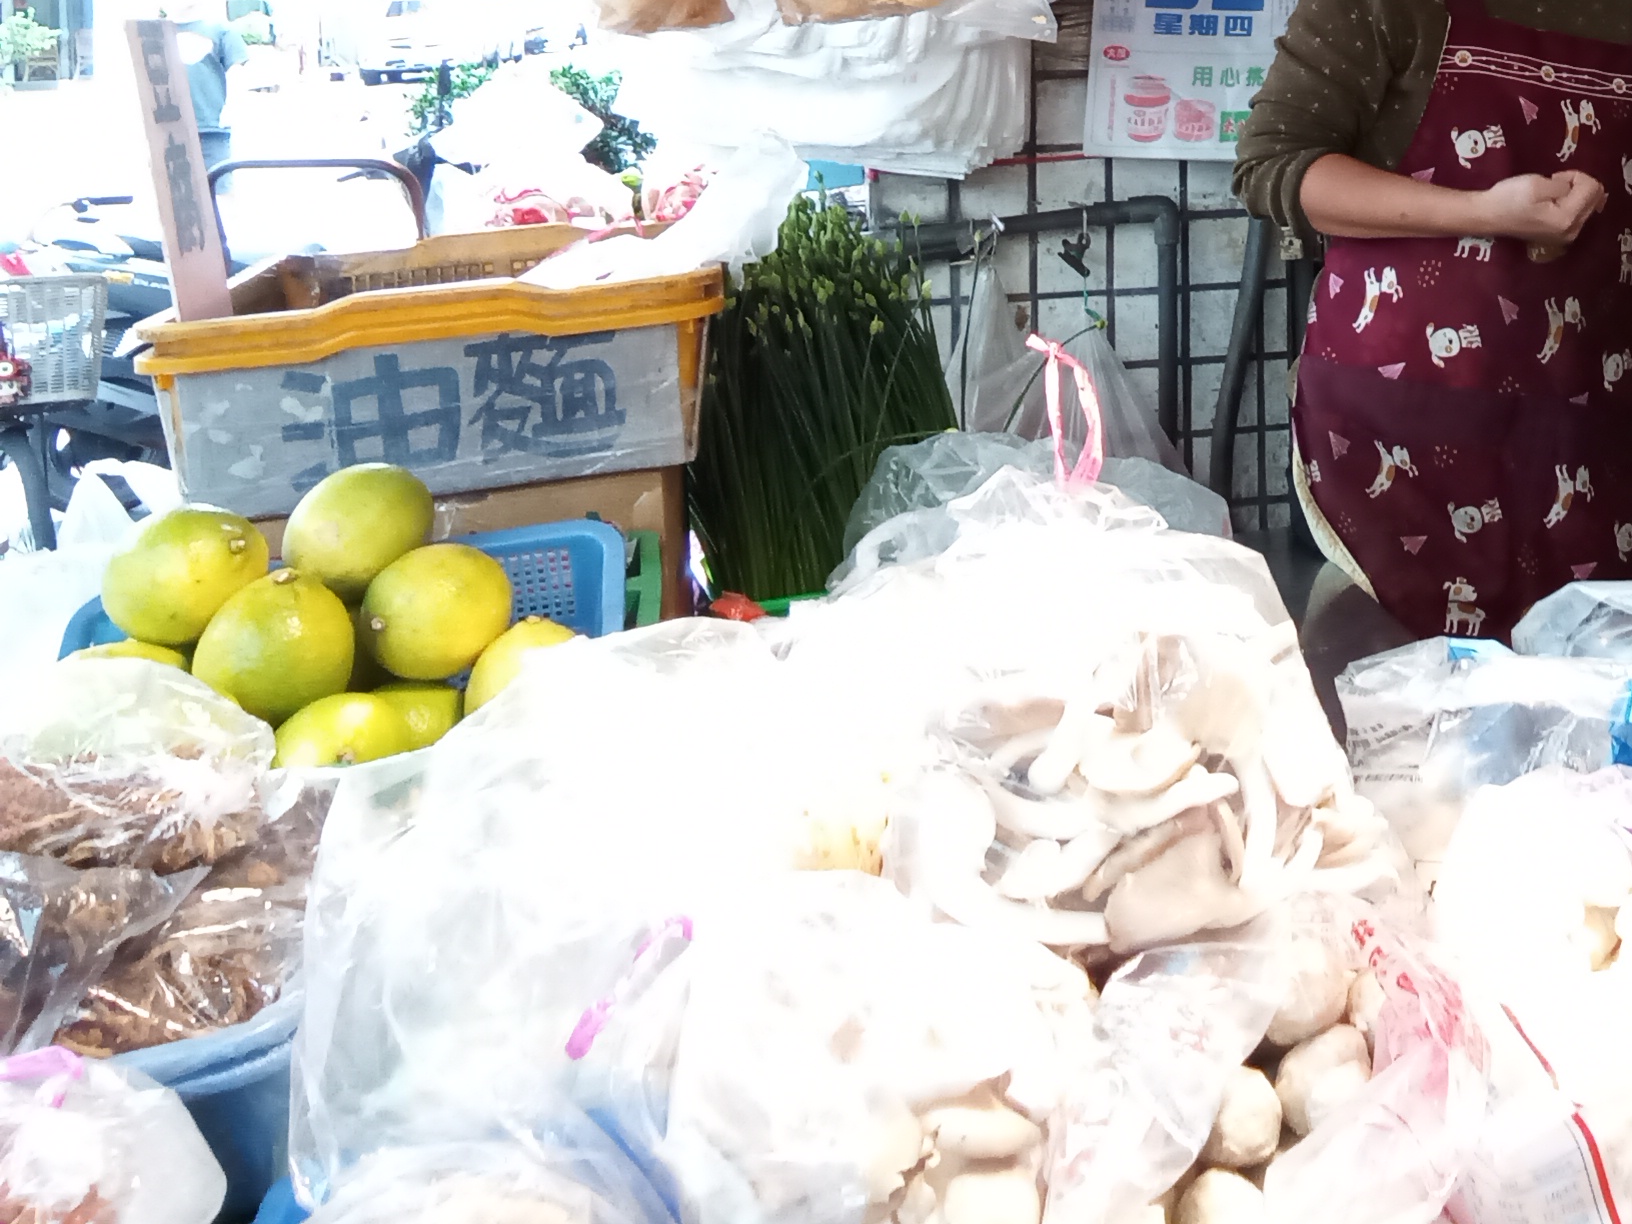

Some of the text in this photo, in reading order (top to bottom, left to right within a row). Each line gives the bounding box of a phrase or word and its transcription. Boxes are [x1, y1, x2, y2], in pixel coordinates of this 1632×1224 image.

[1153, 12, 1254, 37] 星期四
[279, 332, 627, 491] 油麵
